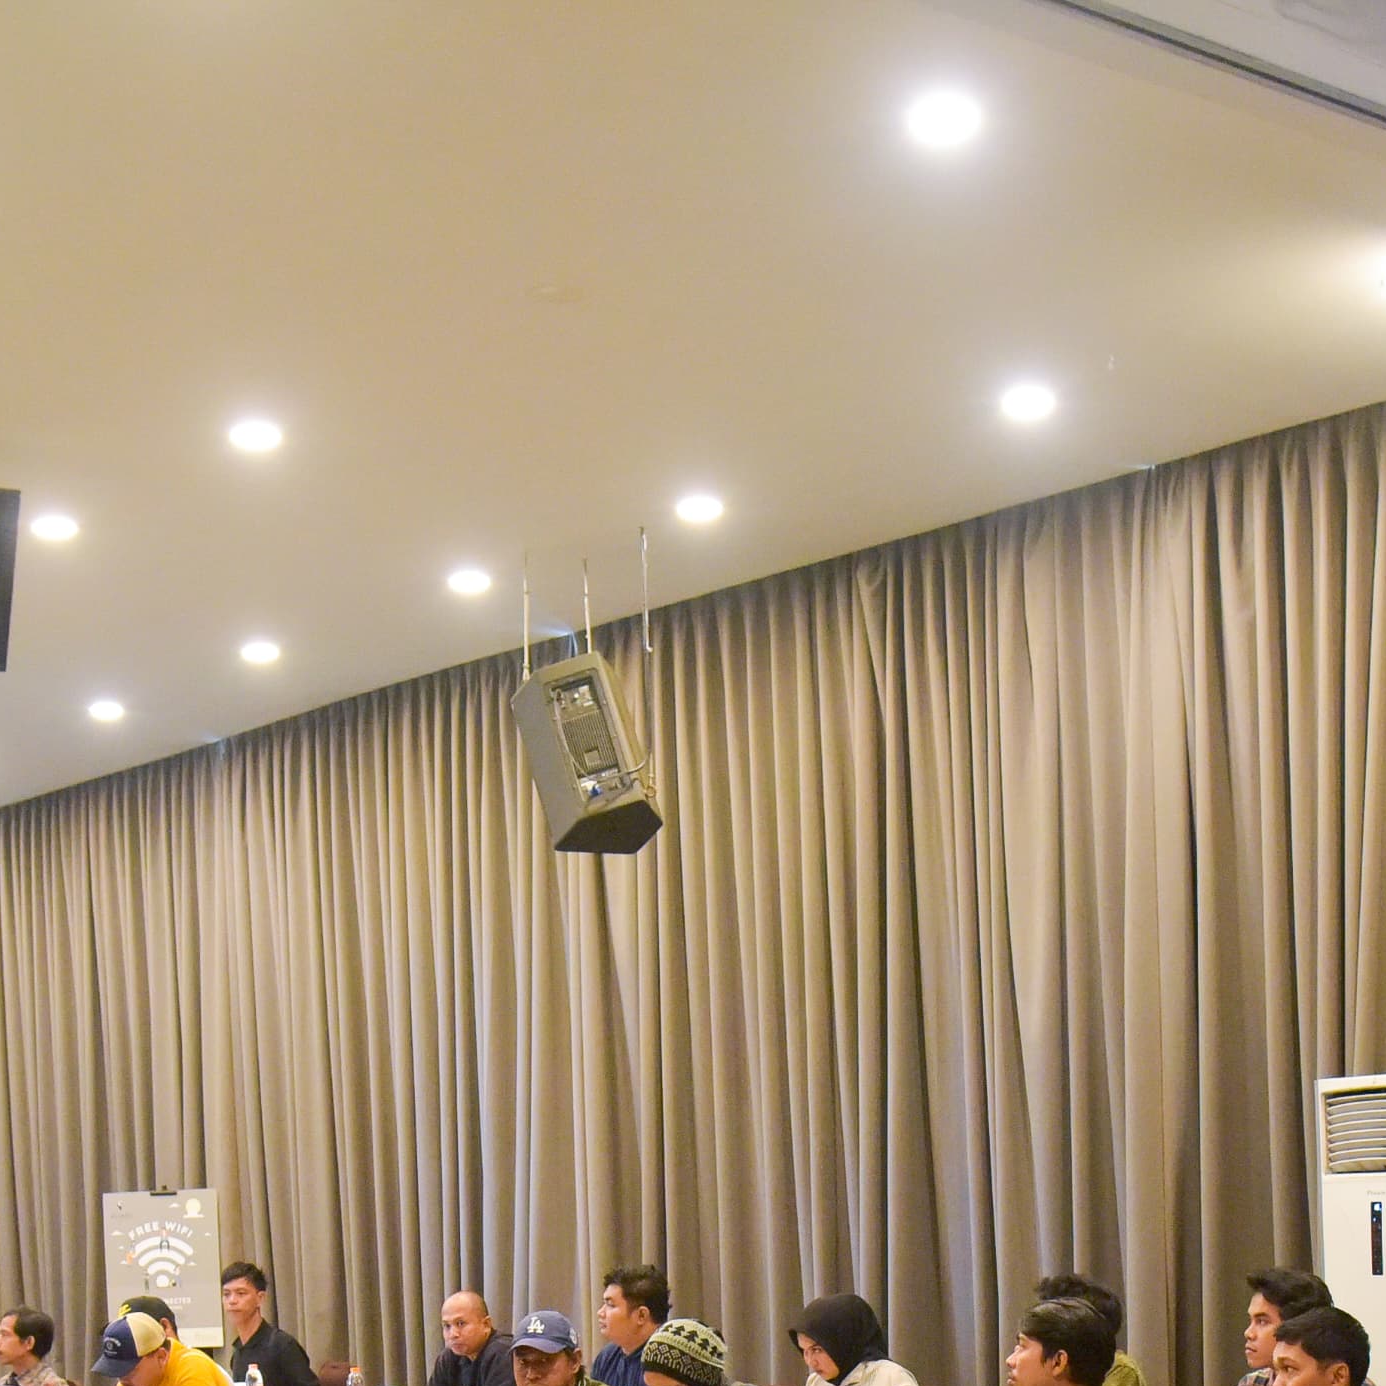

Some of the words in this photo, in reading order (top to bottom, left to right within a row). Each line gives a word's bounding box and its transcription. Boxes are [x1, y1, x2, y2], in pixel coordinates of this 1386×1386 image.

[128, 1221, 160, 1241] FREE
[164, 1221, 193, 1238] WIFI
[526, 1316, 545, 1334] LA
